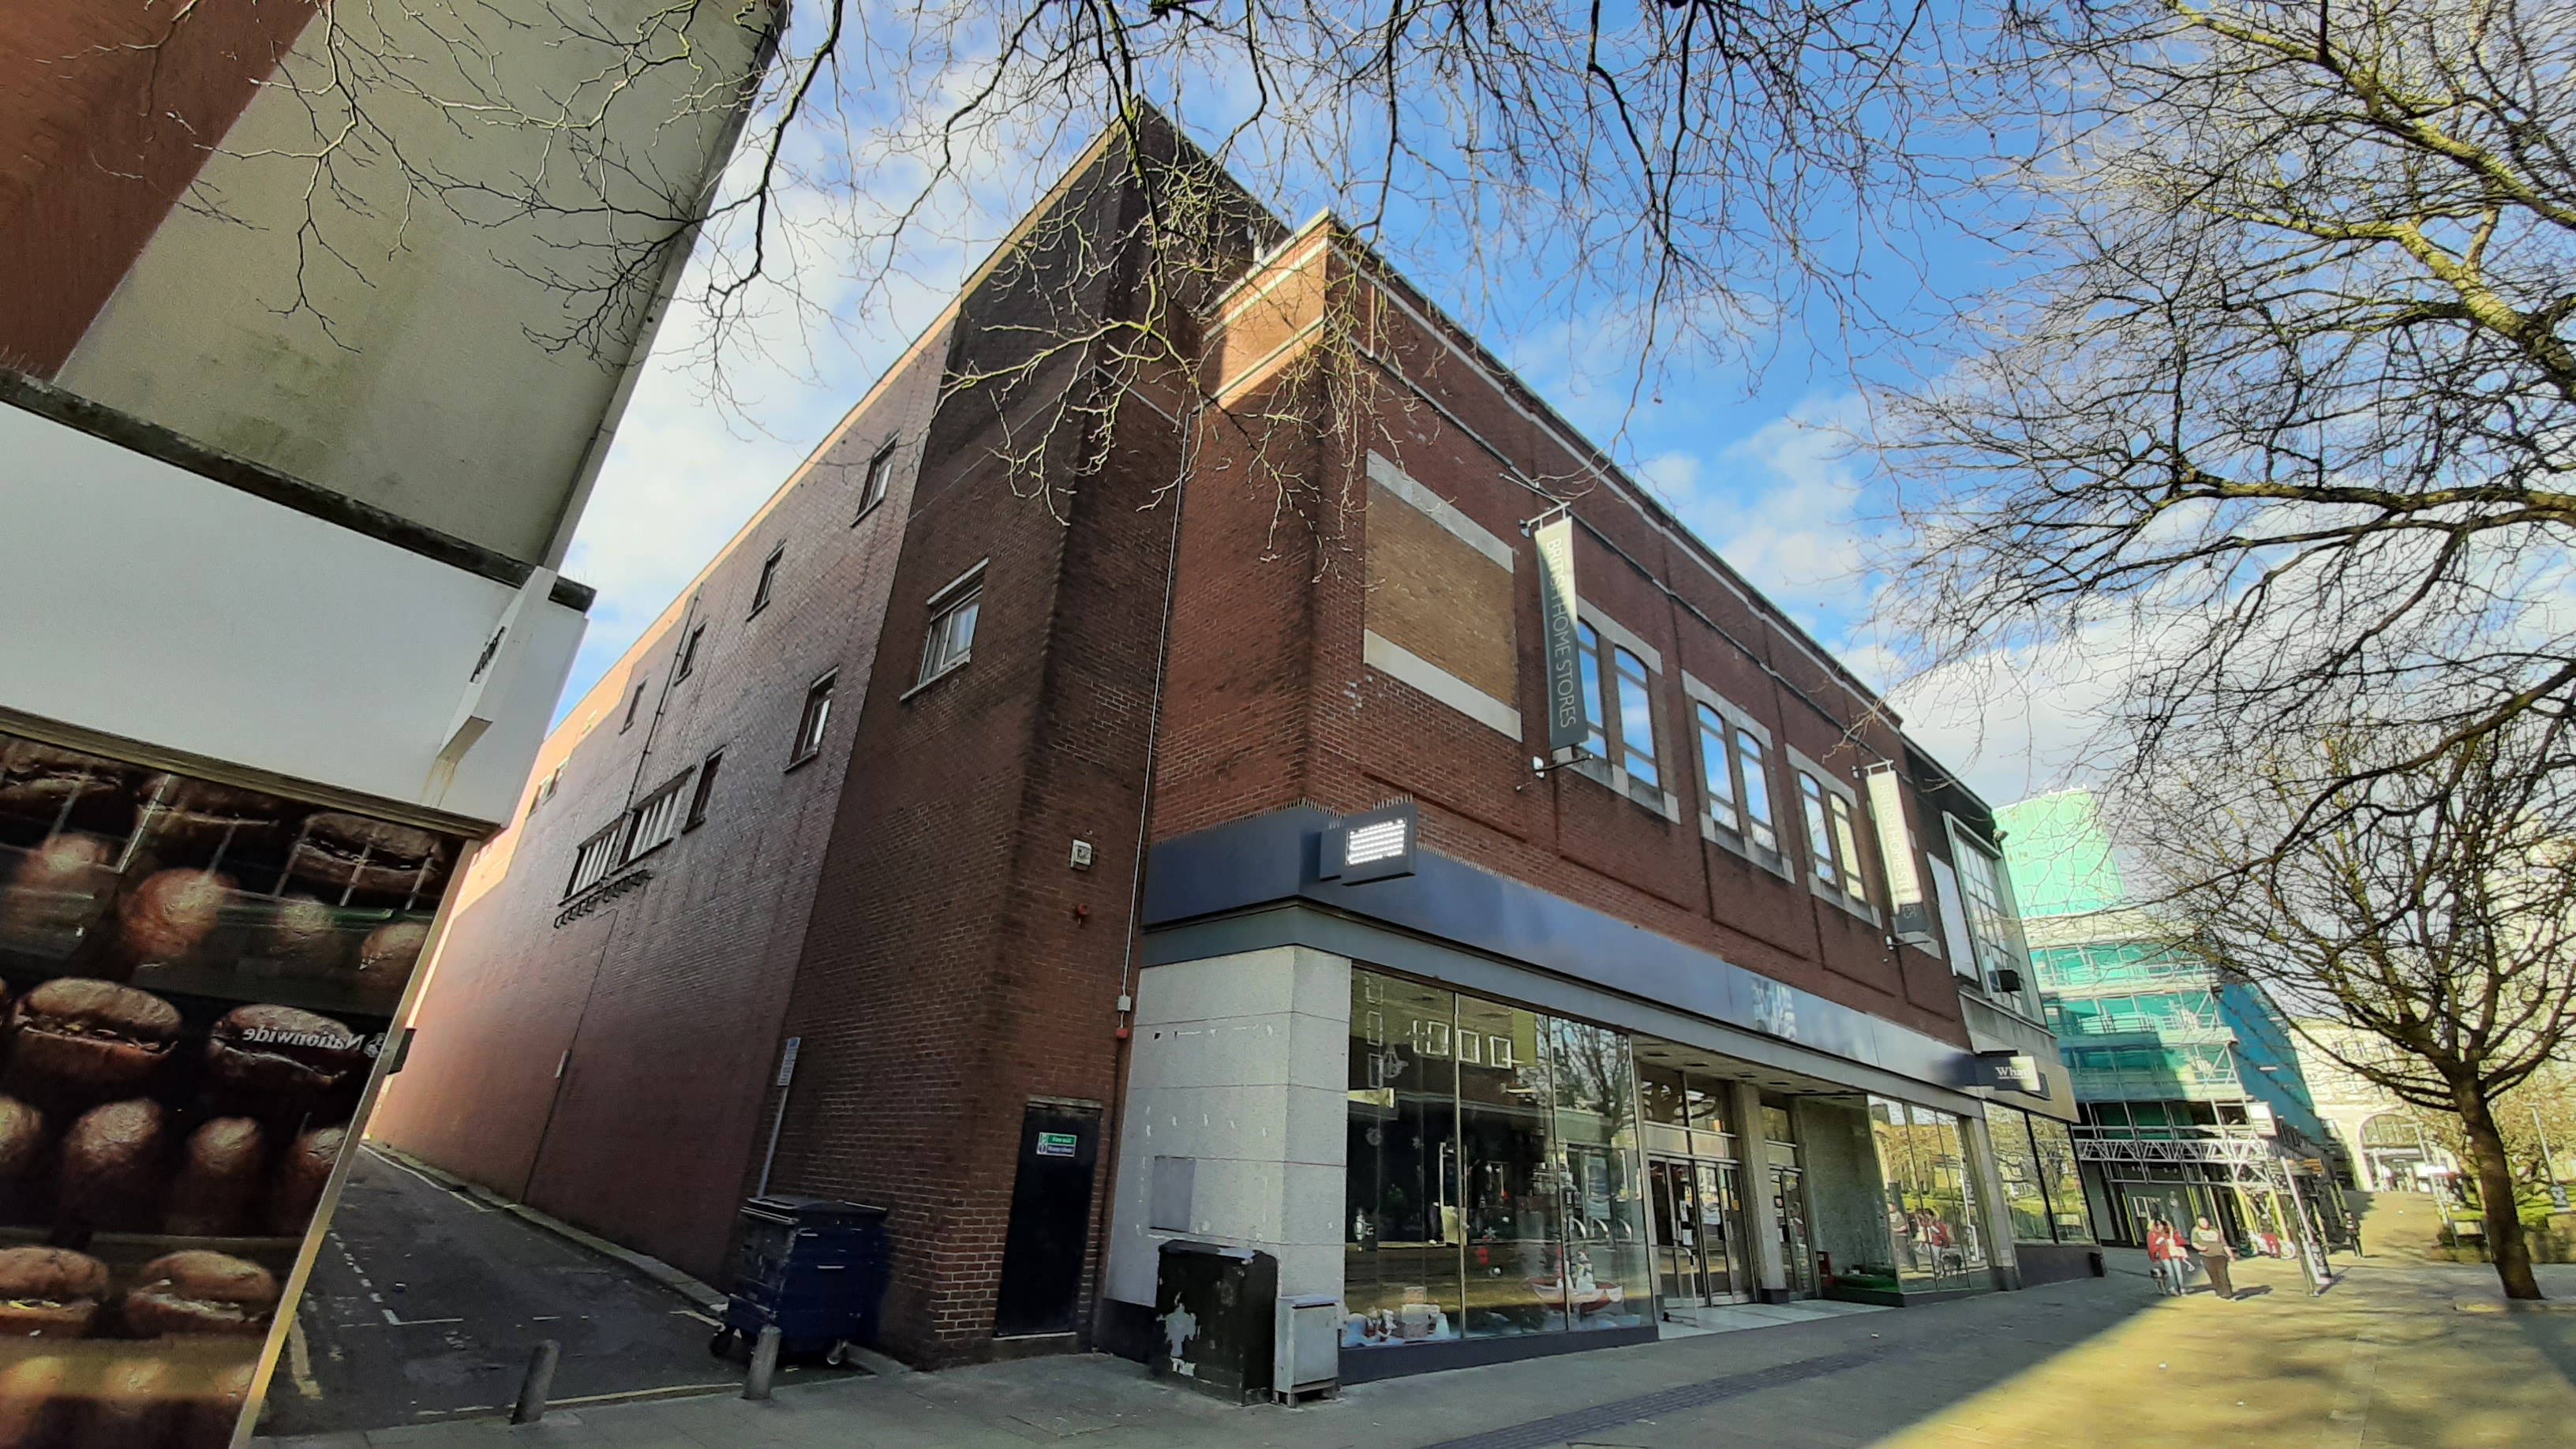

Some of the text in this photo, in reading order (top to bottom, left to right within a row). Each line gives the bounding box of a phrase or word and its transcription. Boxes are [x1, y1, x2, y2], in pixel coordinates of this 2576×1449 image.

[1546, 537, 1577, 728] BRITISH HOME STORES
[1878, 784, 1896, 829] BRITISH
[1887, 829, 1907, 871] HOME
